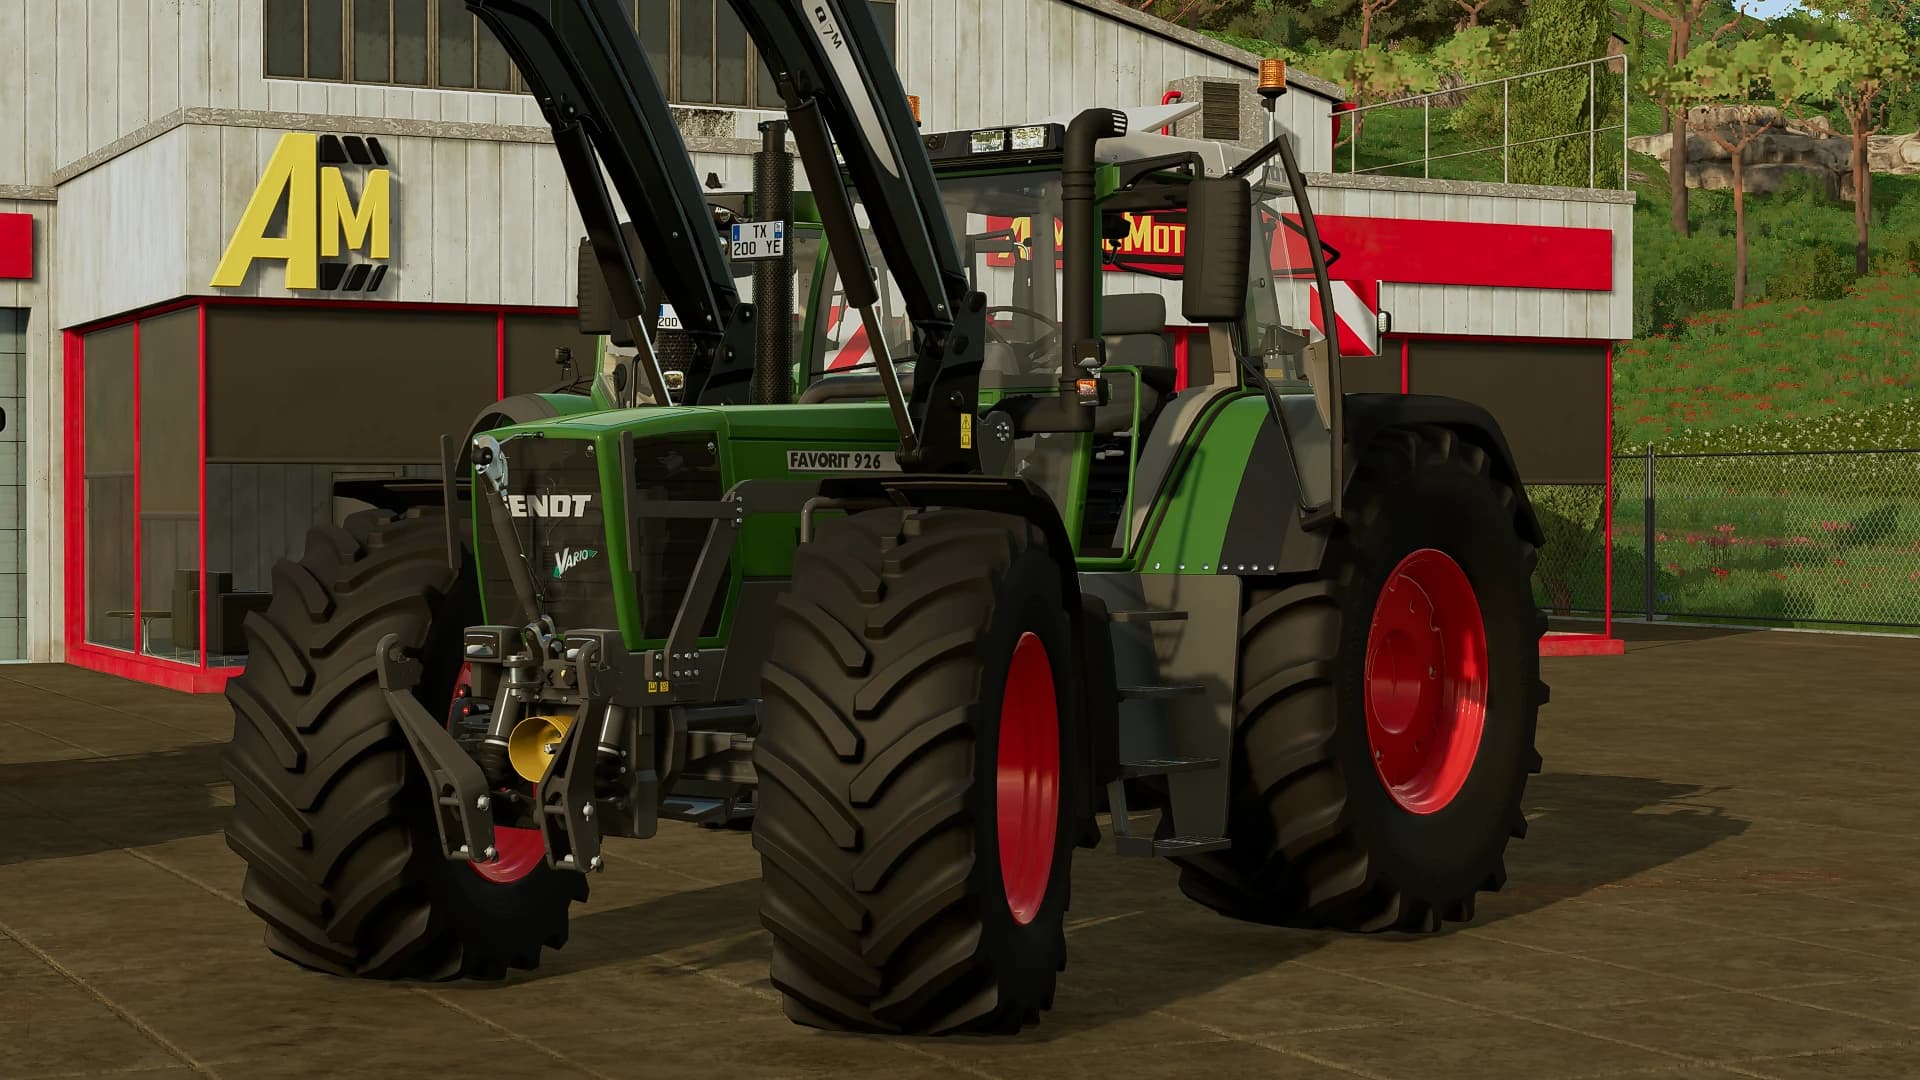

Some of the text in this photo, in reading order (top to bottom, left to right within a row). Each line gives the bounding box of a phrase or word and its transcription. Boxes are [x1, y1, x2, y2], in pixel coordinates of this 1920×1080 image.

[752, 224, 767, 239] TX
[1123, 211, 1186, 254] MOT
[733, 239, 781, 256] 200 YE
[658, 318, 678, 327] 200
[790, 452, 881, 470] FAVORIT 926
